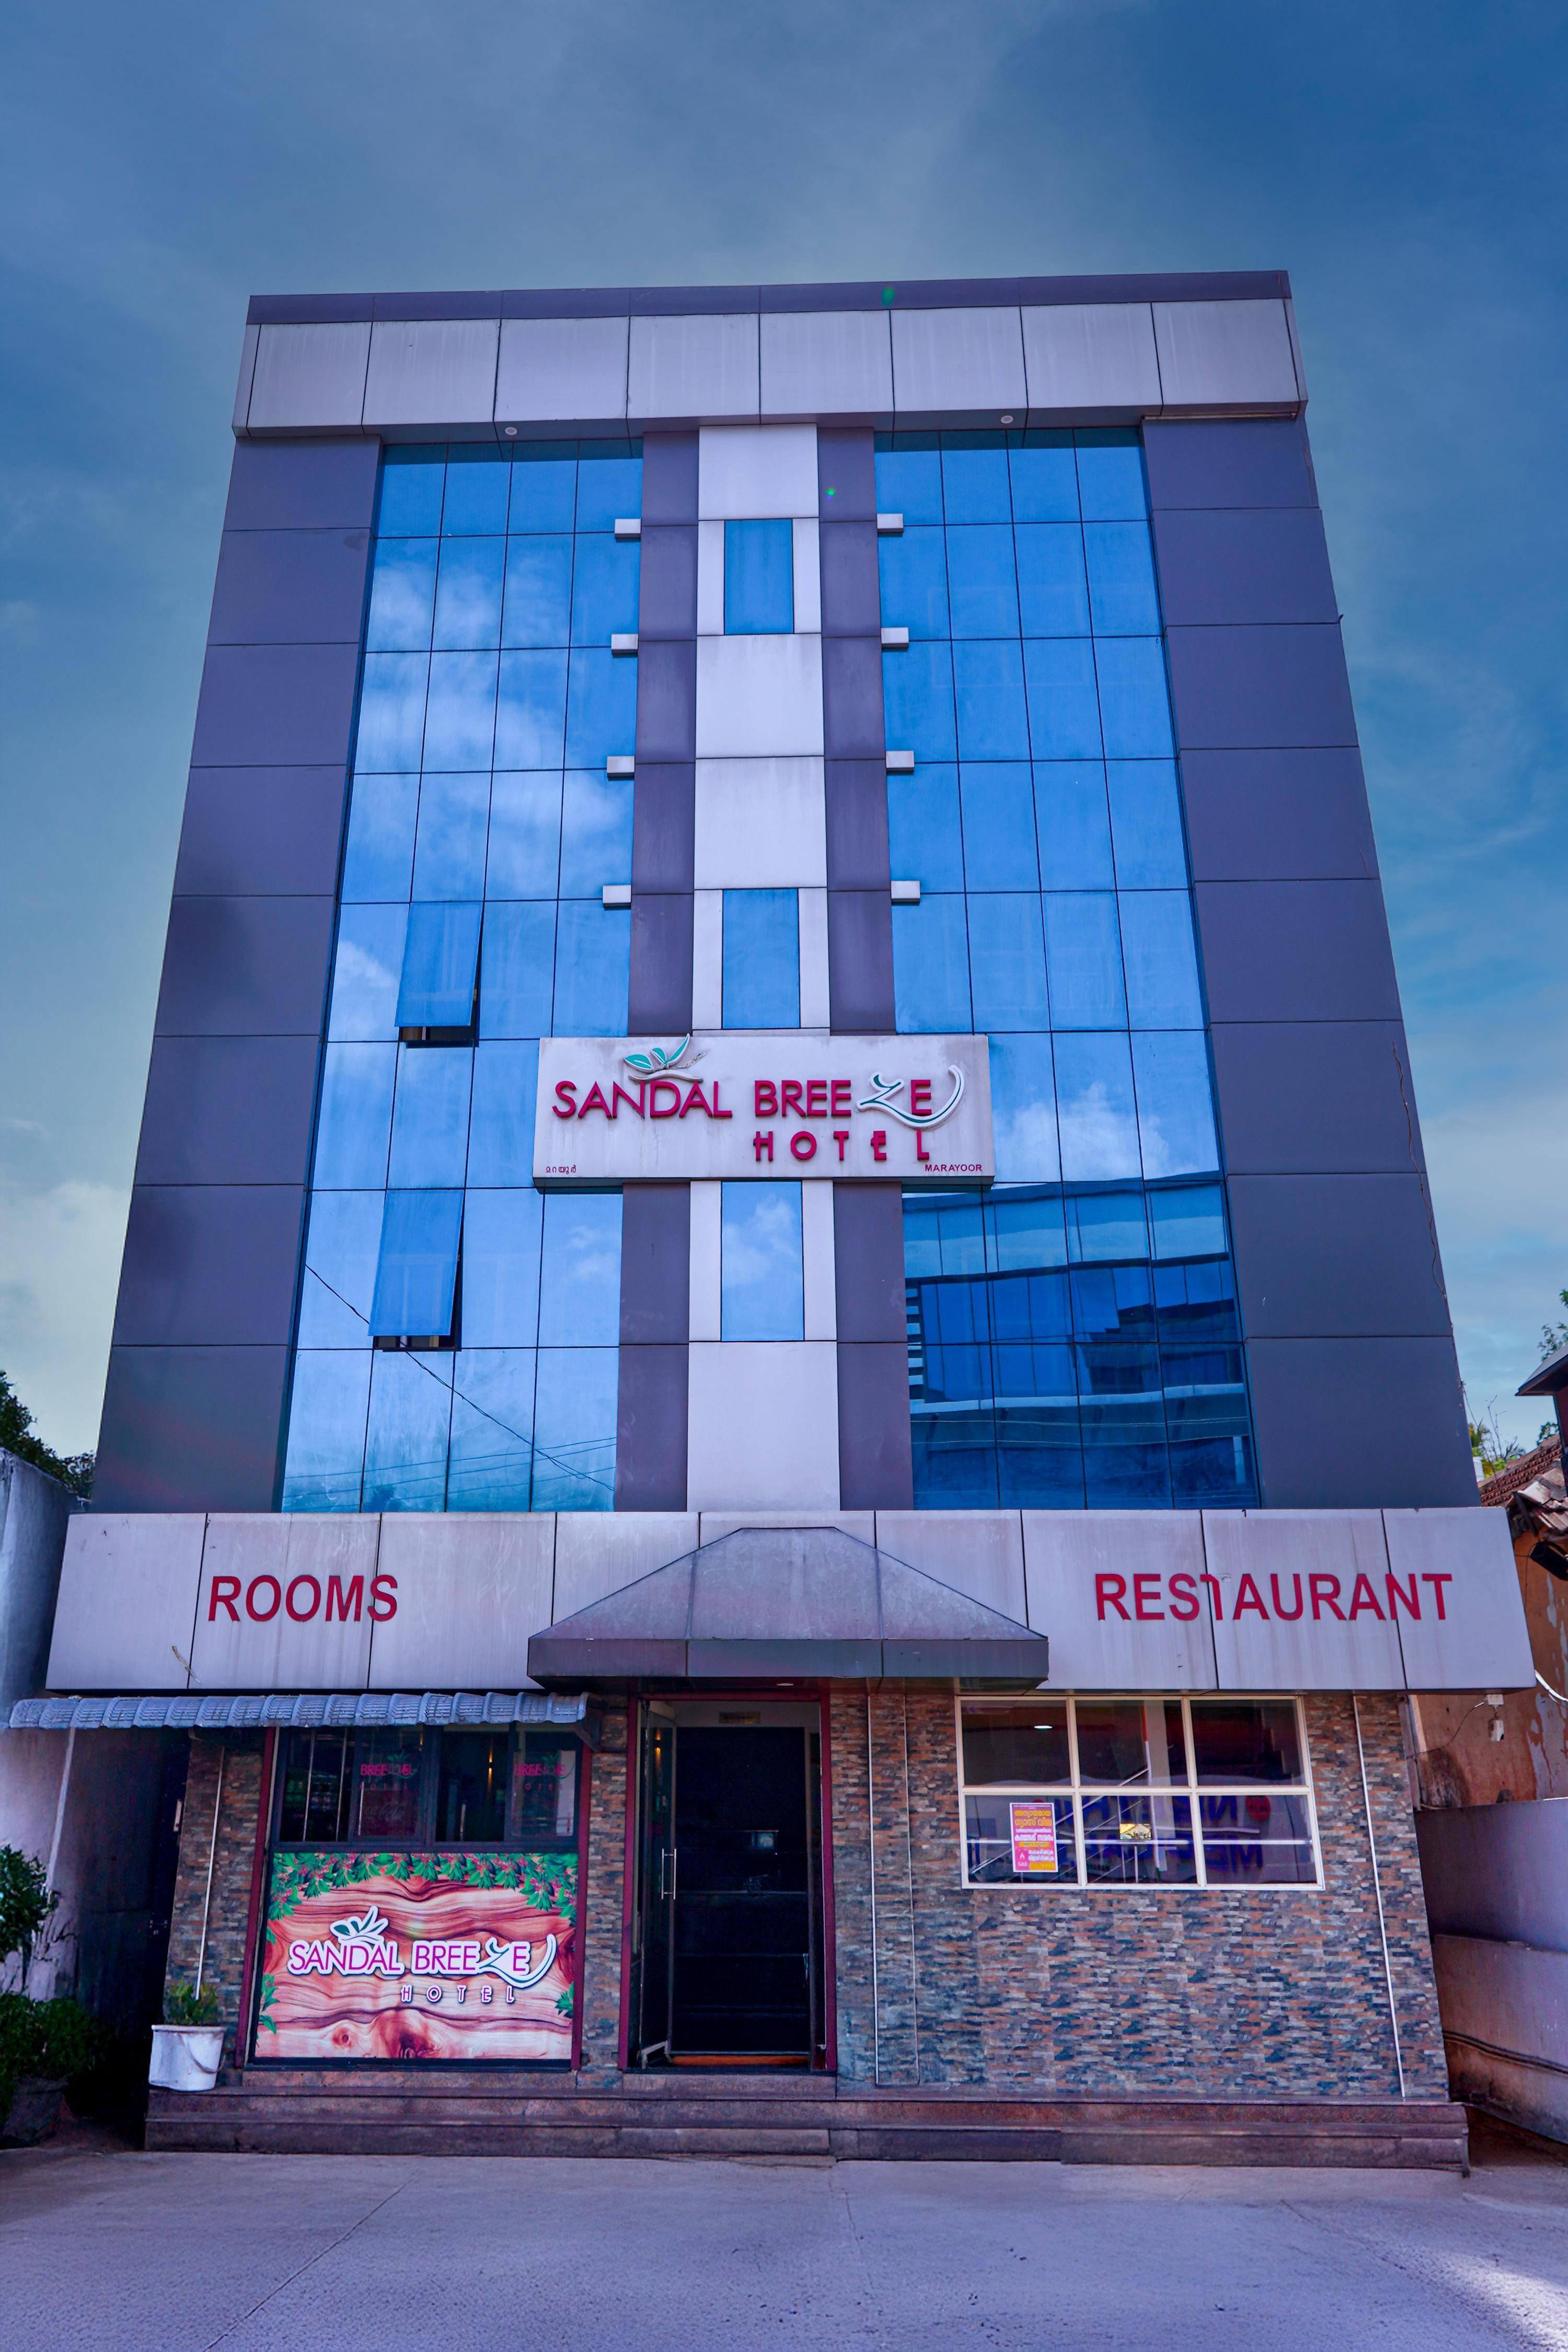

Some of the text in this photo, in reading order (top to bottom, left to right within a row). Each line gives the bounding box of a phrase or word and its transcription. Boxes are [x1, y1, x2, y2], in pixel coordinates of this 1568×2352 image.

[552, 1070, 941, 1125] SANDAL BREEZE
[753, 1129, 930, 1162] HOTEL
[546, 1165, 577, 1174] മറയൂർ
[208, 1574, 398, 1622] ROOMS
[1095, 1573, 1452, 1621] RESTAURANT
[290, 1939, 534, 1978] SANDAL BREEZE
[401, 1987, 514, 2002] HOTEL
